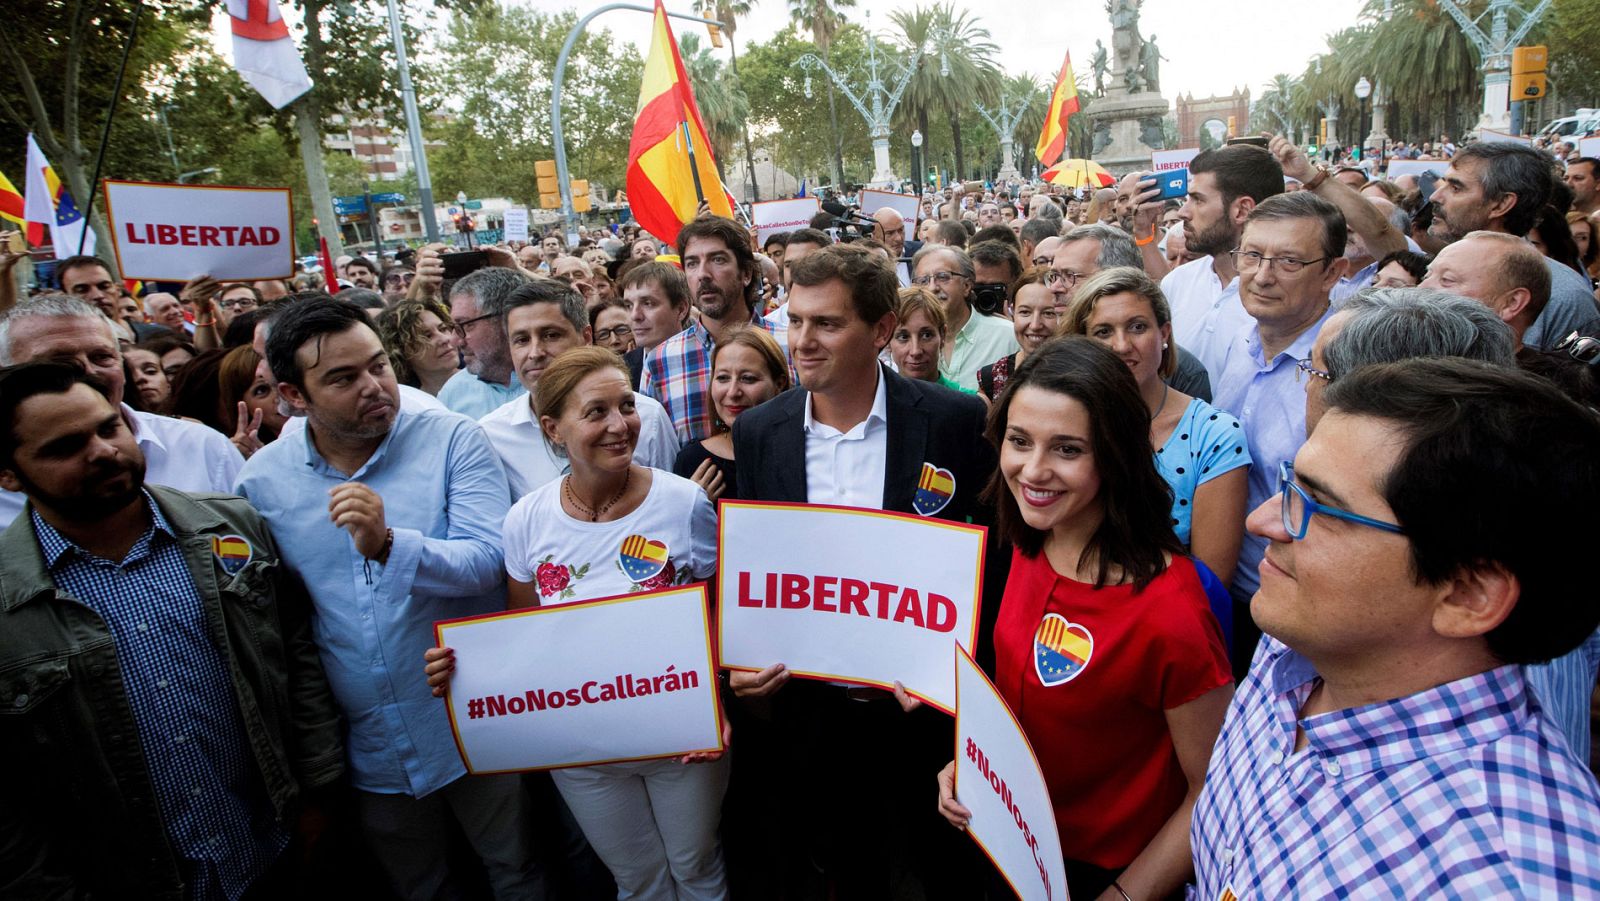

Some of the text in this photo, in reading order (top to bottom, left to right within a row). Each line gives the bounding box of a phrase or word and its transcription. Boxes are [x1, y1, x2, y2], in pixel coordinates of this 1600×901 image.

[1156, 161, 1190, 170] LIBERTA
[125, 222, 280, 247] LIBERTAD
[738, 571, 958, 633] LIBERTAD
[468, 665, 699, 719] #NoNosCallarán
